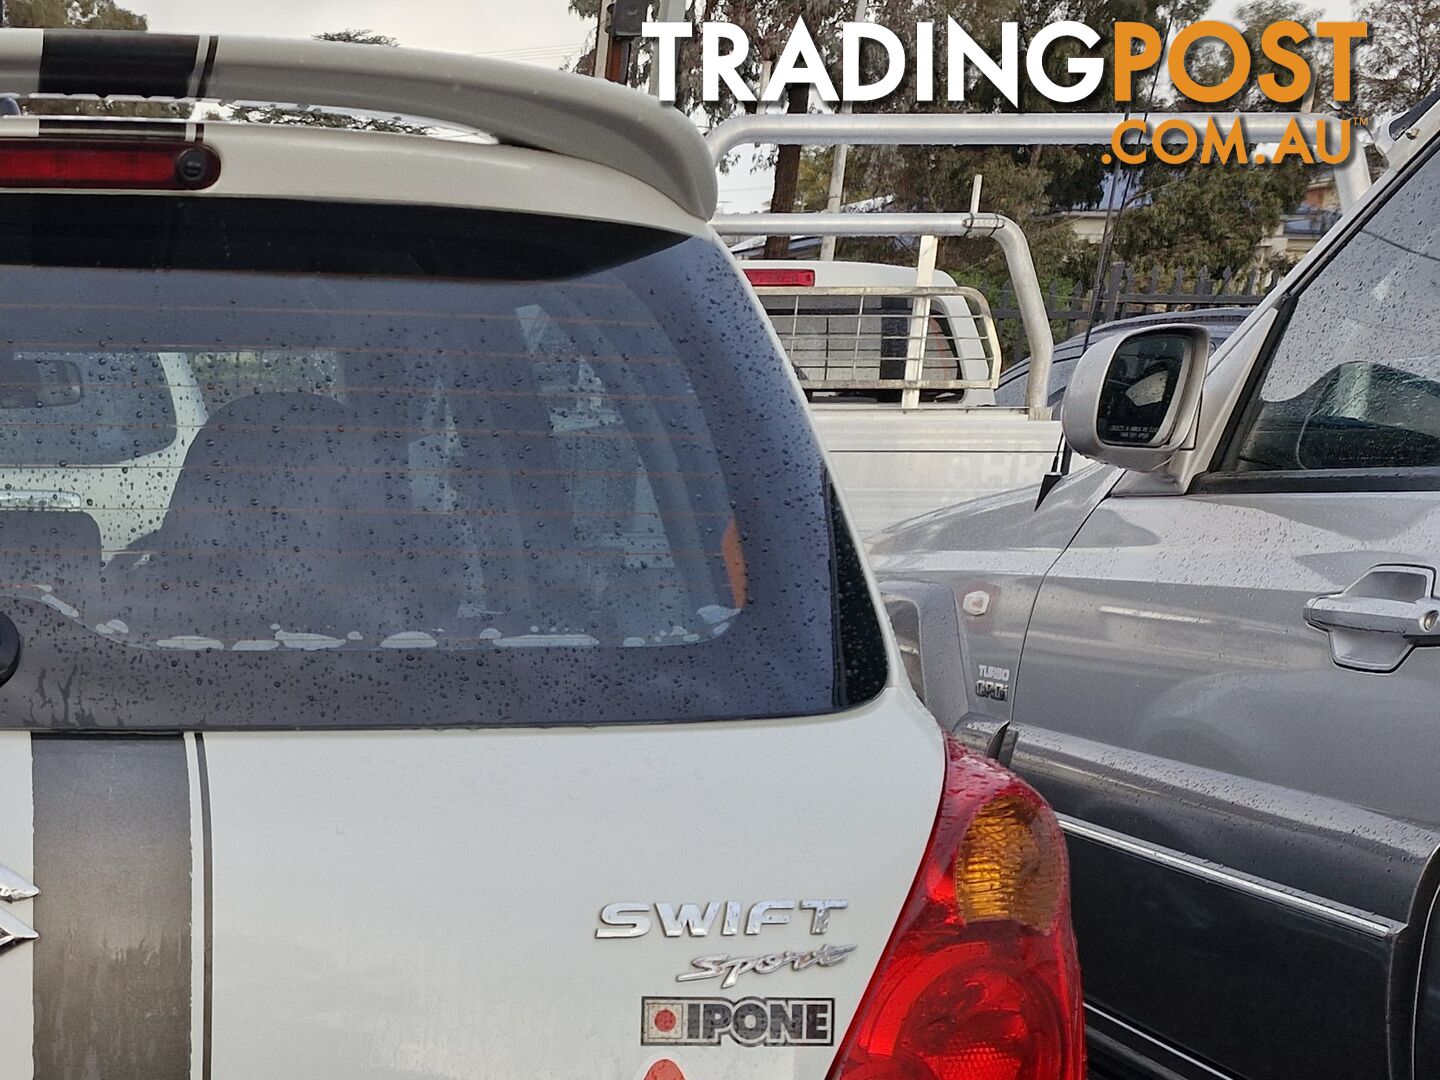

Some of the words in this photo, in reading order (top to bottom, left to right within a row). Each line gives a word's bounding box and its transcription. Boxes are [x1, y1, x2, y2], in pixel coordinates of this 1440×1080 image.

[979, 664, 1010, 682] TURBO
[595, 900, 848, 938] SWIFT
[676, 943, 858, 989] Sport
[686, 999, 830, 1041] IPONE
